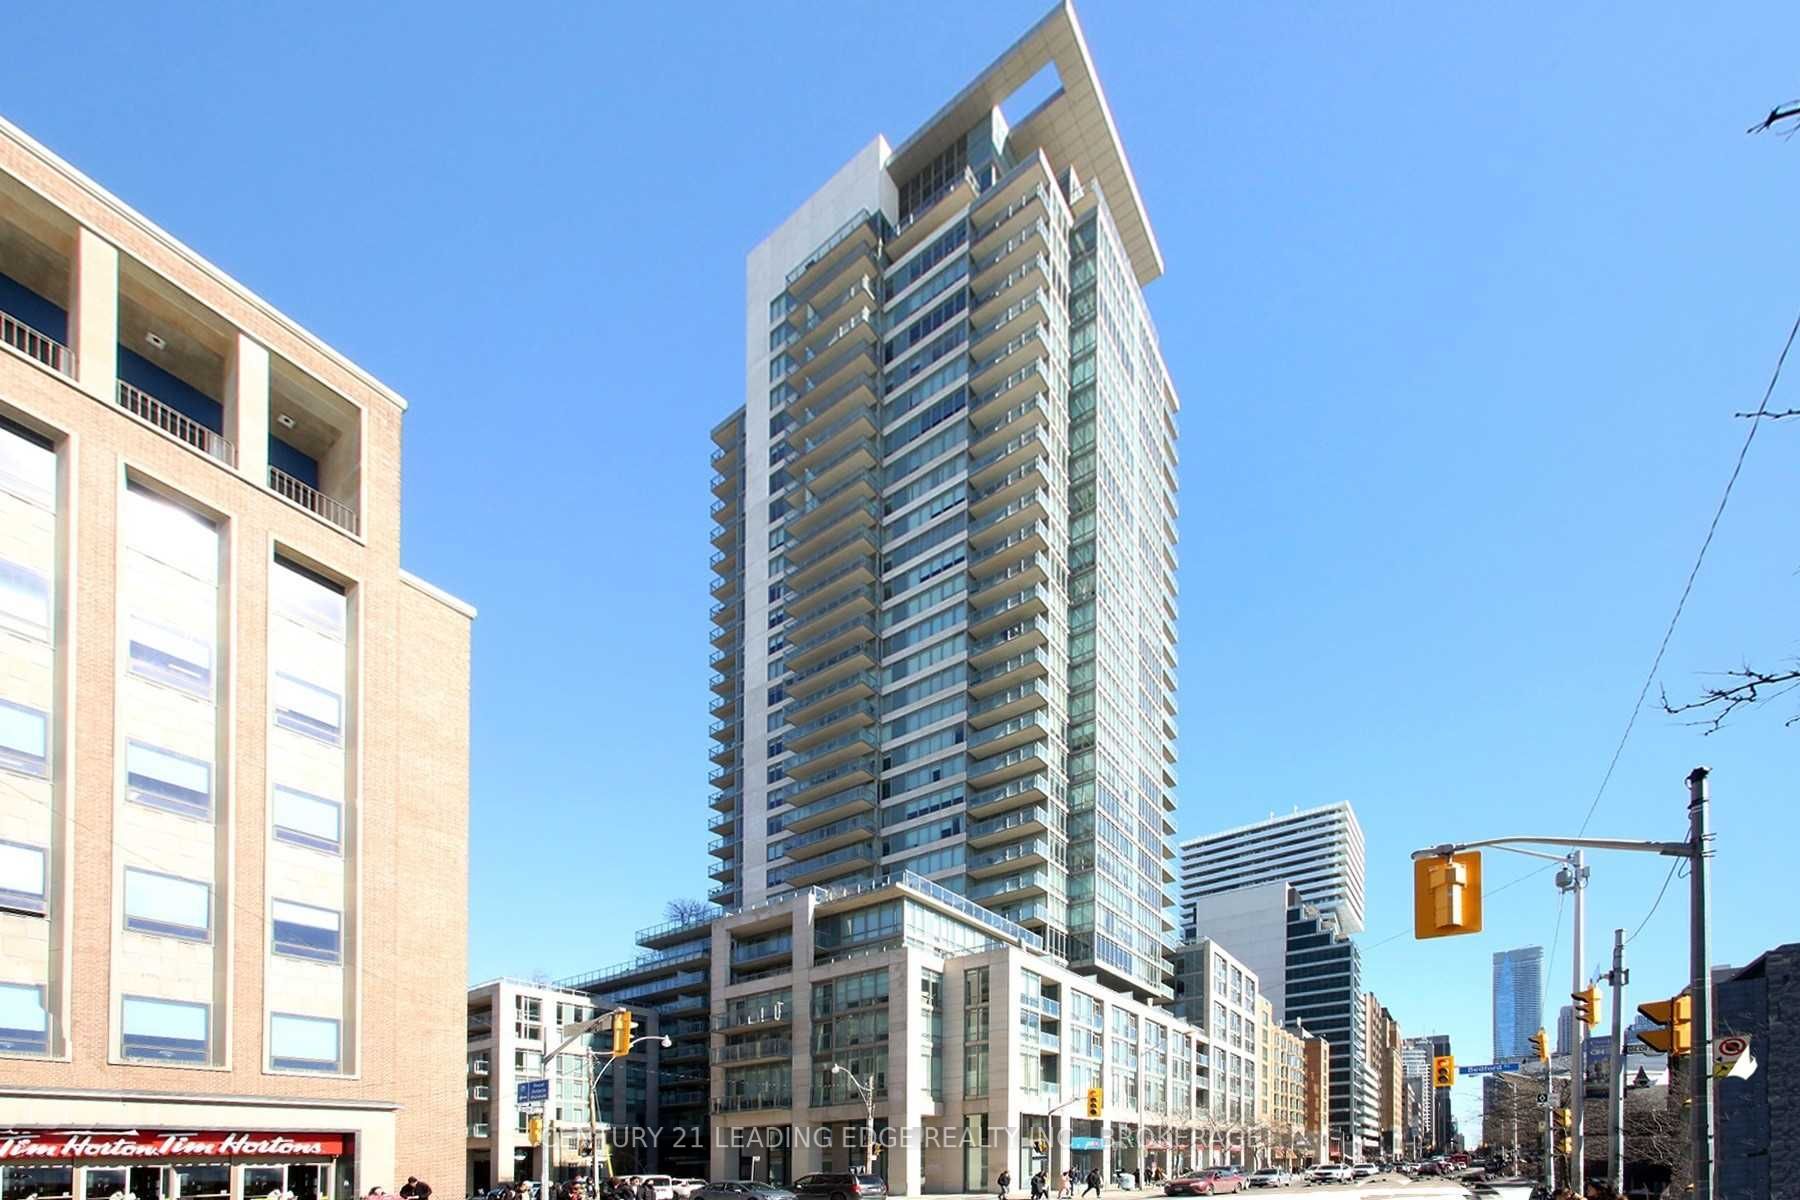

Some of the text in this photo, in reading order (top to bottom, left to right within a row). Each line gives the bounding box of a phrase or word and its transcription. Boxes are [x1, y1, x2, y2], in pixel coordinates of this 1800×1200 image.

[1467, 1064, 1503, 1073] Bedford
[0, 1135, 59, 1158] Tim
[157, 1133, 322, 1155] Tim Hortons
